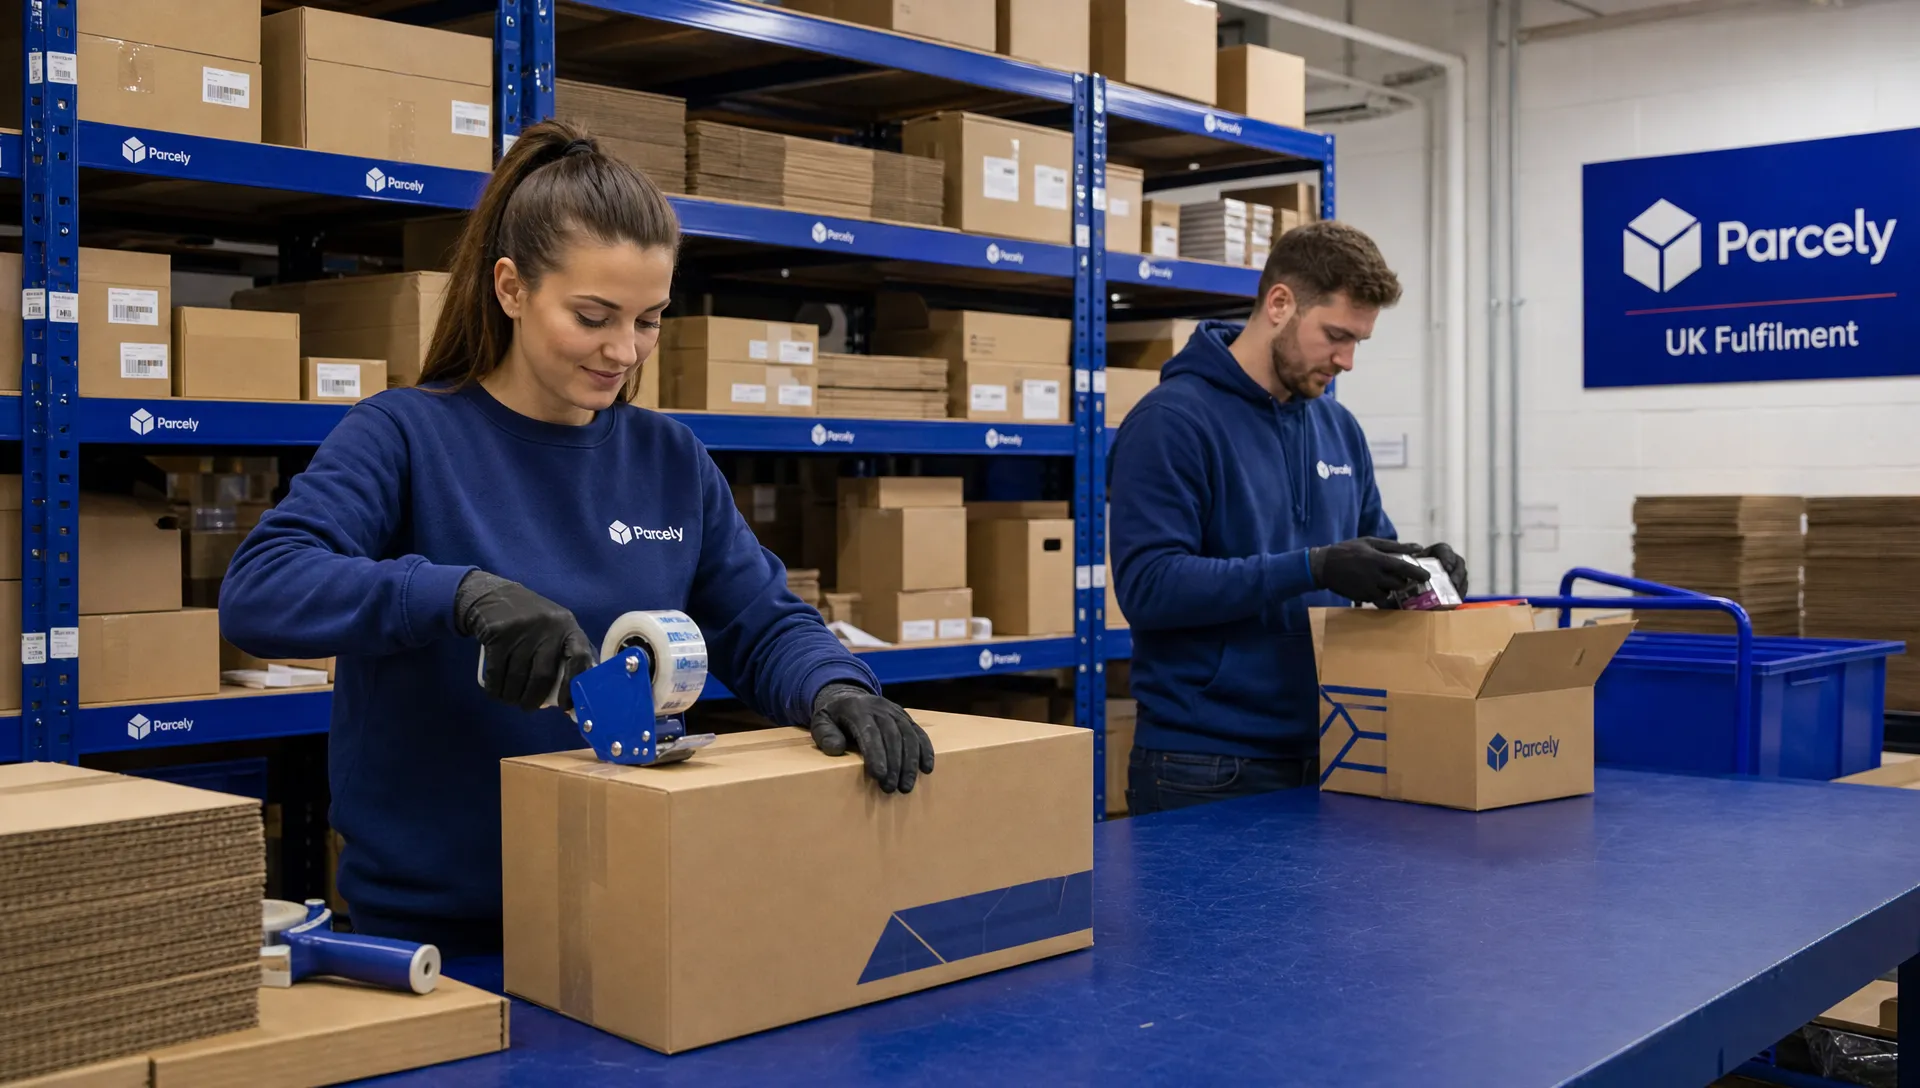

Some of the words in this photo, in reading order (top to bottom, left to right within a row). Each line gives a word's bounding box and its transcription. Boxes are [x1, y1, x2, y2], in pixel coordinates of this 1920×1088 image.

[149, 147, 191, 166] Parcely
[388, 177, 424, 195] Parcely
[1718, 208, 1897, 265] Parcely
[1666, 327, 1708, 356] UK
[1714, 321, 1859, 354] Fulfilment
[158, 417, 199, 432] Parcely
[633, 526, 684, 542] Parcely
[153, 717, 194, 732] Parcely
[1514, 735, 1560, 760] Parcely
